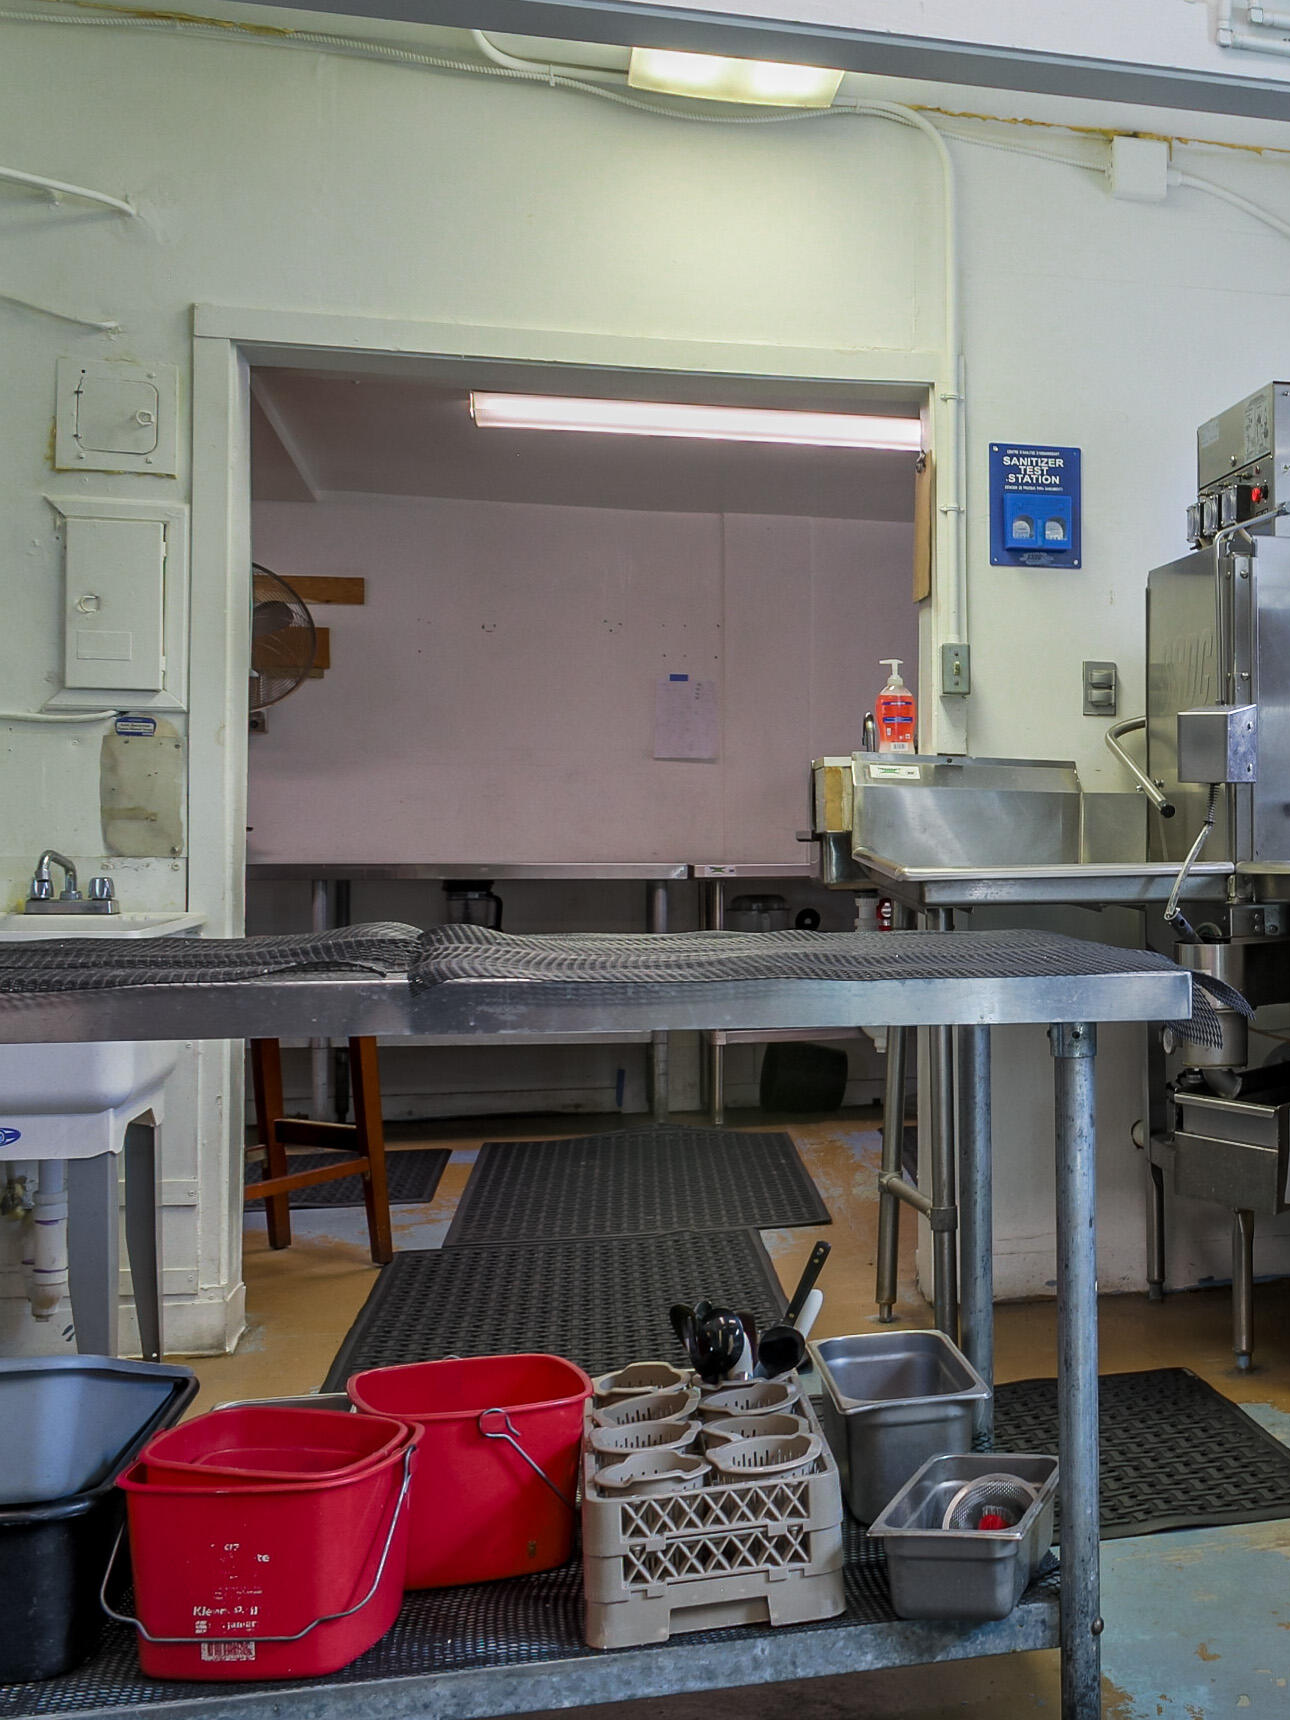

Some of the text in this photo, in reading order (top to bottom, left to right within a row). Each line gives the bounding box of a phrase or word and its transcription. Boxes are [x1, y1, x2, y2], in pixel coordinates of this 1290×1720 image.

[1003, 456, 1064, 467] SANITIZER
[1019, 466, 1049, 475] TEST
[1008, 473, 1060, 485] STATION
